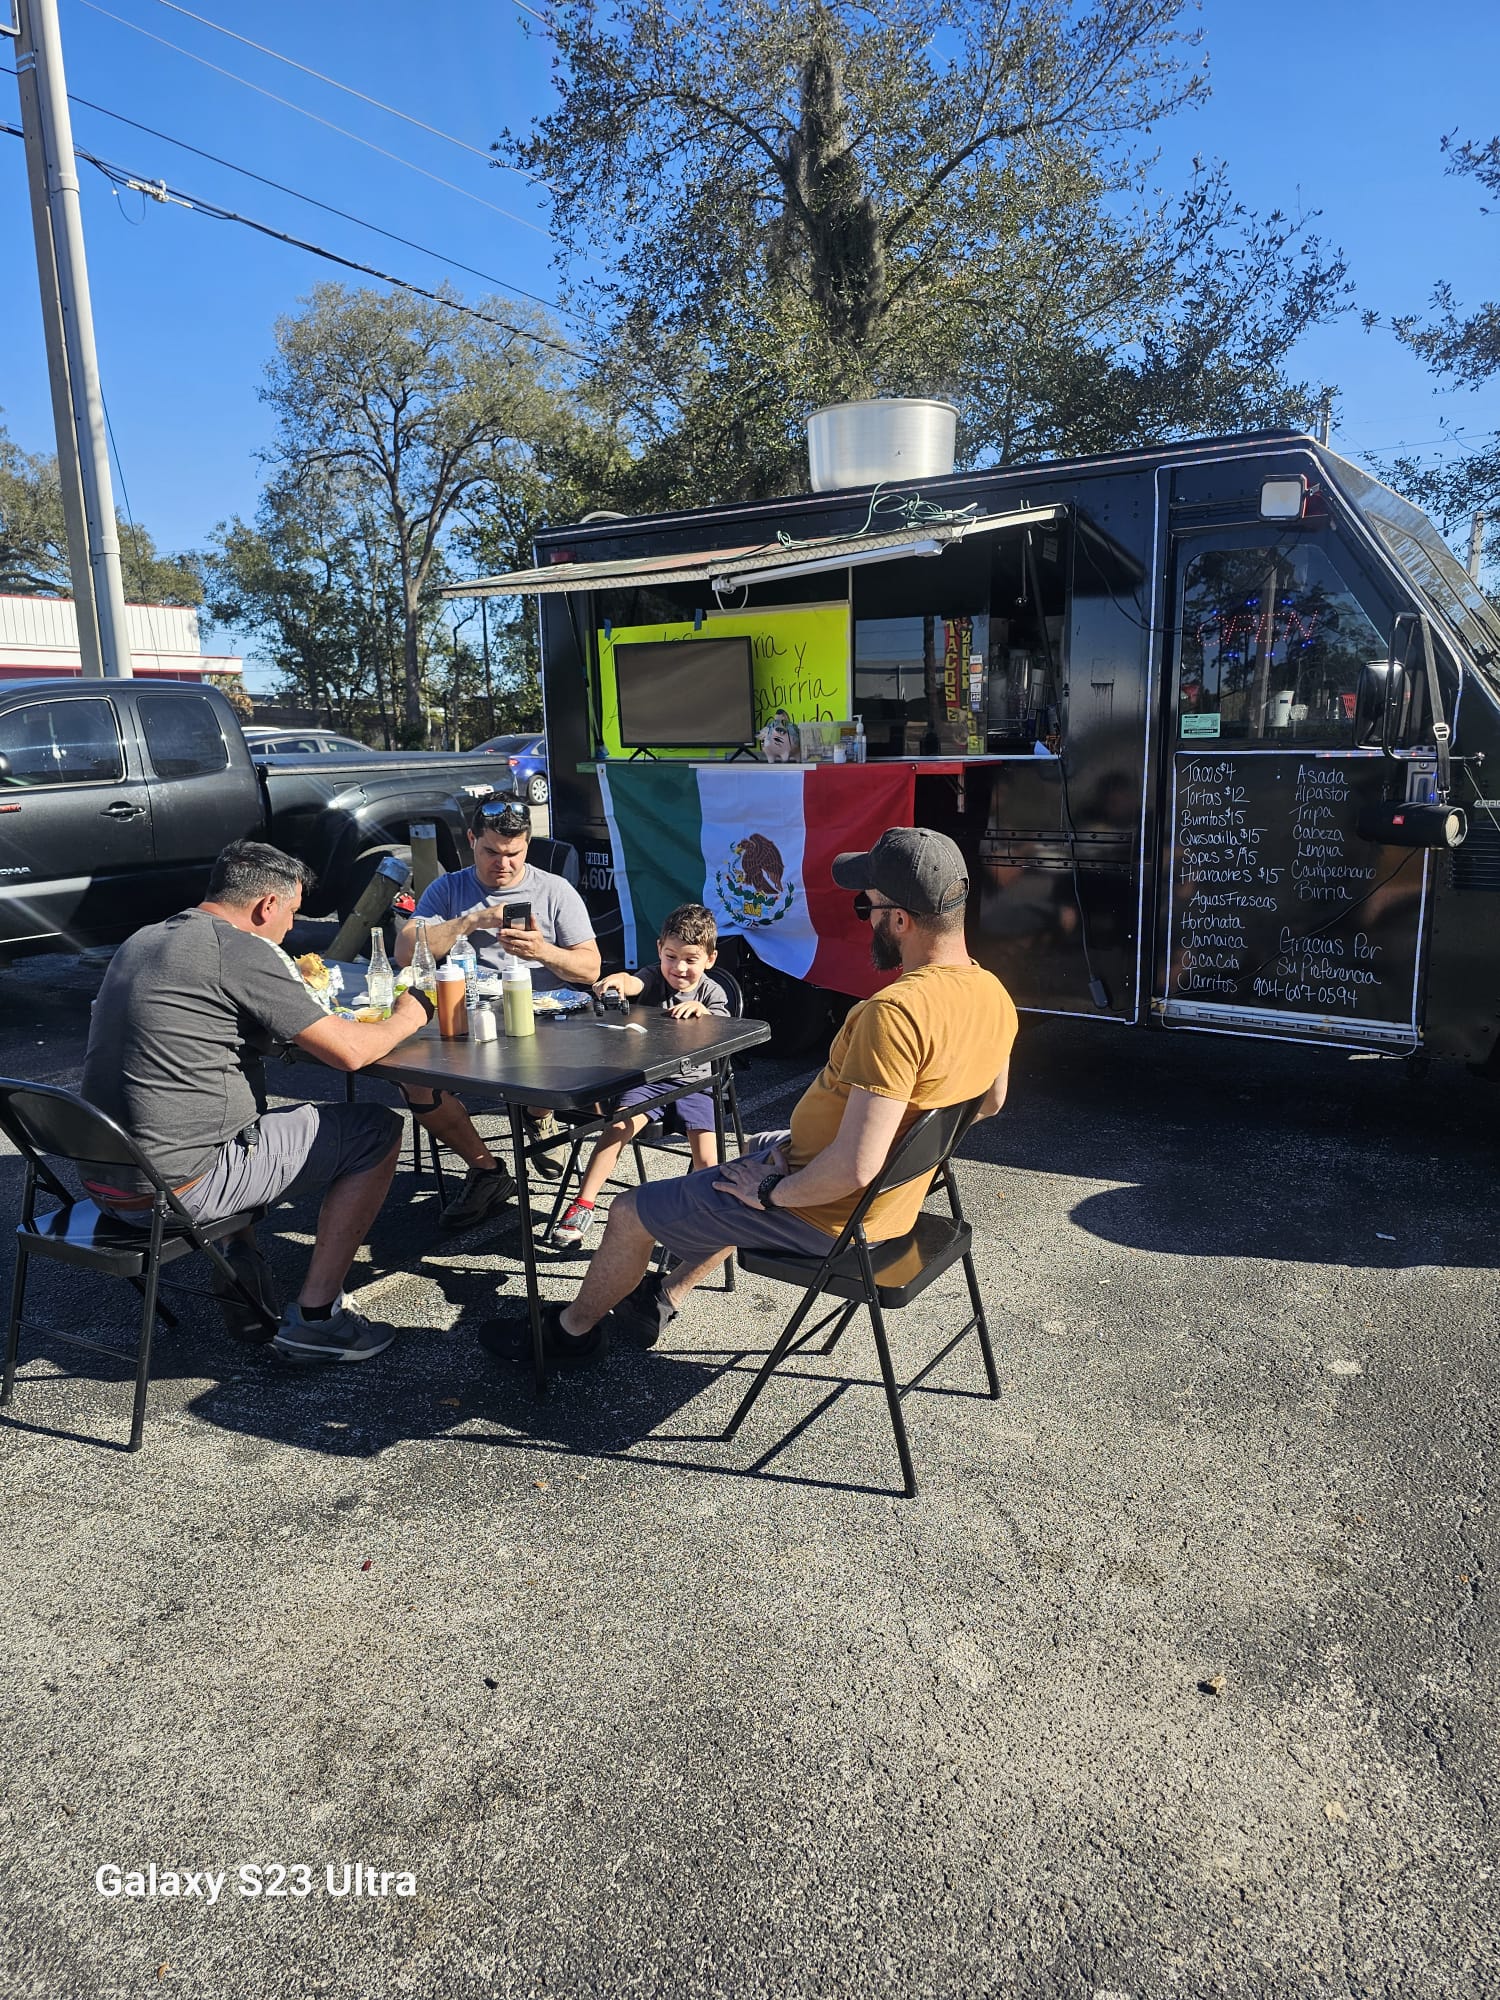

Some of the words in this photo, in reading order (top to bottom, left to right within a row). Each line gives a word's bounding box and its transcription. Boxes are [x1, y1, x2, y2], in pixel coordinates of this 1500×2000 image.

[1196, 609, 1319, 647] OPEN
[945, 620, 958, 702] TACOS
[753, 672, 838, 712] sabirria
[1297, 764, 1348, 785] Asada
[1180, 784, 1222, 808] Tortas
[1224, 786, 1251, 802] $12
[1289, 802, 1335, 826] Tripa
[1180, 827, 1242, 847] Quesadilla
[1240, 828, 1268, 844] $15
[1292, 824, 1344, 842] Cabeza
[1182, 848, 1220, 867] Sopes
[1297, 842, 1343, 866] Lengua
[1180, 864, 1252, 885] Huaraches
[1258, 867, 1285, 885] $15
[1291, 859, 1377, 883] Campechano
[1294, 880, 1352, 901] Birria
[1180, 912, 1246, 929] Horchata
[1181, 930, 1248, 948] Jamaica
[1280, 926, 1344, 956] Gracias
[1354, 932, 1382, 960] Por
[1177, 966, 1238, 992] Jarritos
[1277, 956, 1297, 976] Su
[1300, 953, 1381, 985] Preferencia
[1253, 977, 1358, 1009] 904-607-0594
